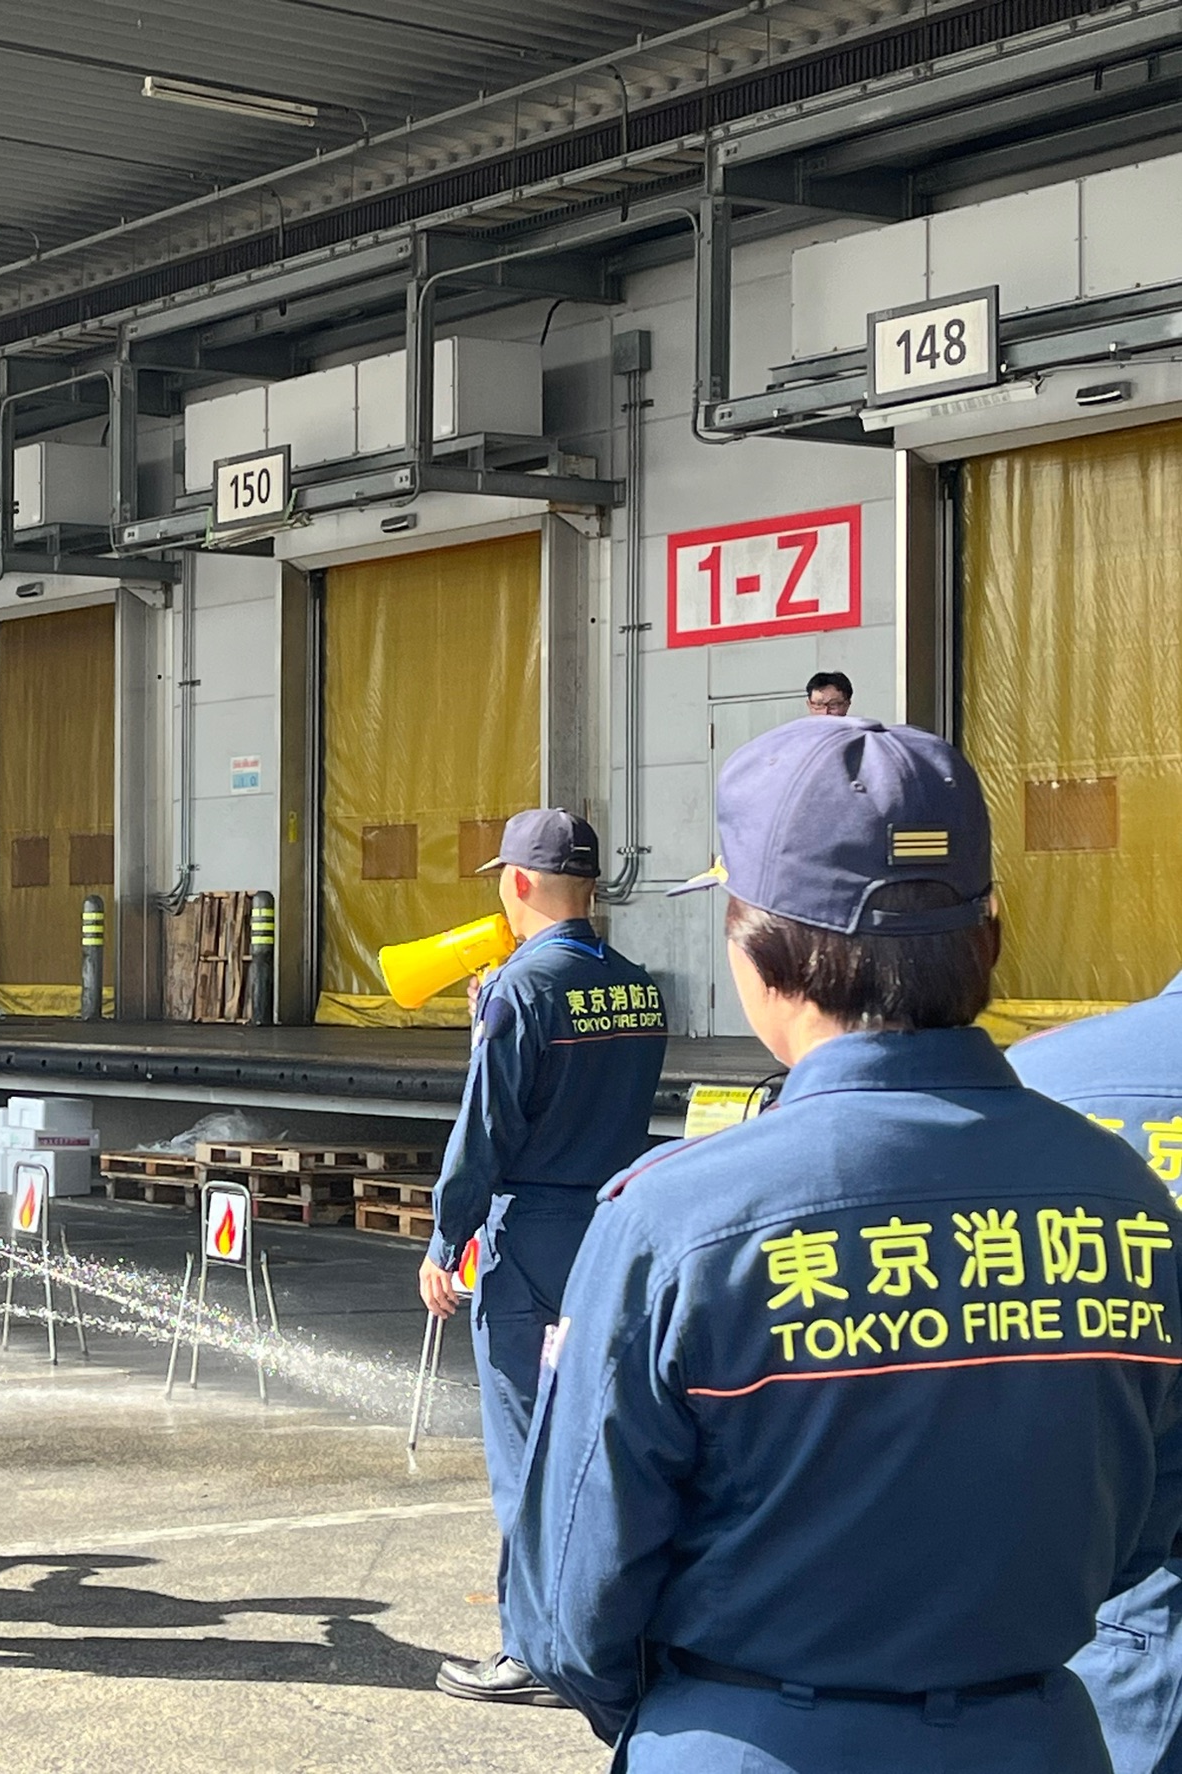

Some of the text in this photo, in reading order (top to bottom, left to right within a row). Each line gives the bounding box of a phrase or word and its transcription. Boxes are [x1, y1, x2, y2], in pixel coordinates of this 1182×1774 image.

[896, 318, 966, 375] 148
[230, 467, 270, 509] 150
[698, 530, 819, 625] 1-Z
[565, 983, 659, 1016] 東京消防庁
[572, 1012, 664, 1033] TOKYO FIRE DEPT.
[760, 1206, 1172, 1310] 東京消防庁
[770, 1298, 1172, 1361] TOKYO FIRE DEPT.
